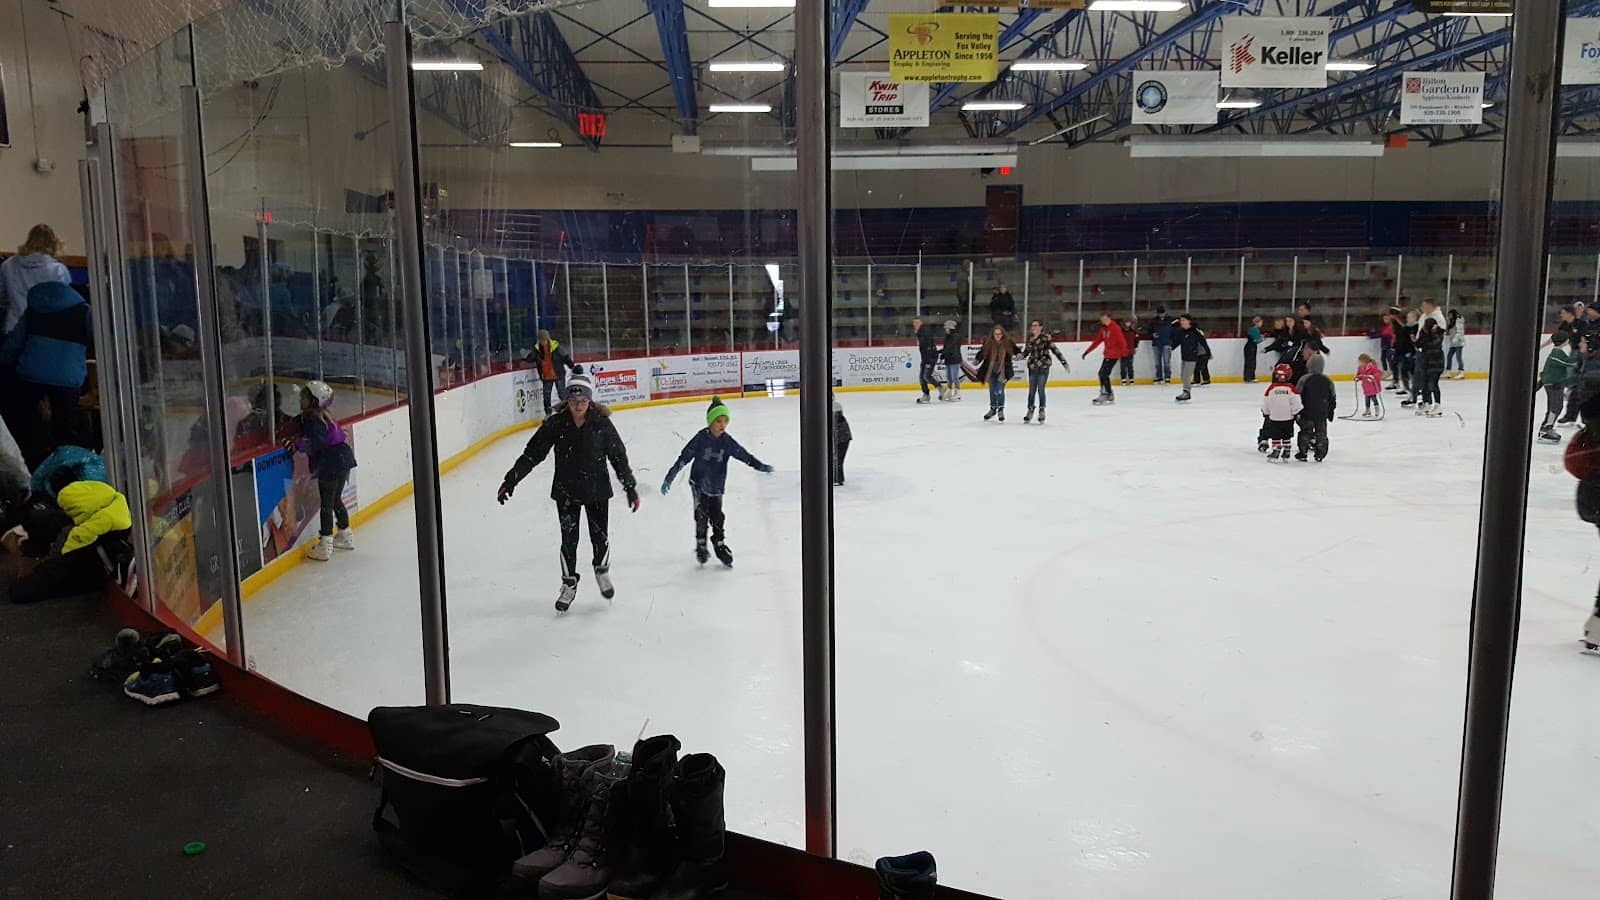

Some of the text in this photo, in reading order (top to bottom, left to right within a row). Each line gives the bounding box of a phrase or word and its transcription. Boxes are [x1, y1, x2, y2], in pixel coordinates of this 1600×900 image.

[955, 32, 993, 41] Serving the
[971, 42, 991, 50] Valley
[893, 49, 951, 60] APPLETON
[955, 52, 993, 60] Since 1956
[1261, 46, 1323, 65] Keller
[1422, 84, 1480, 94] Garden Inn
[849, 355, 907, 365] CHIROPRACTIC
[849, 363, 896, 372] ADVANTAGE
